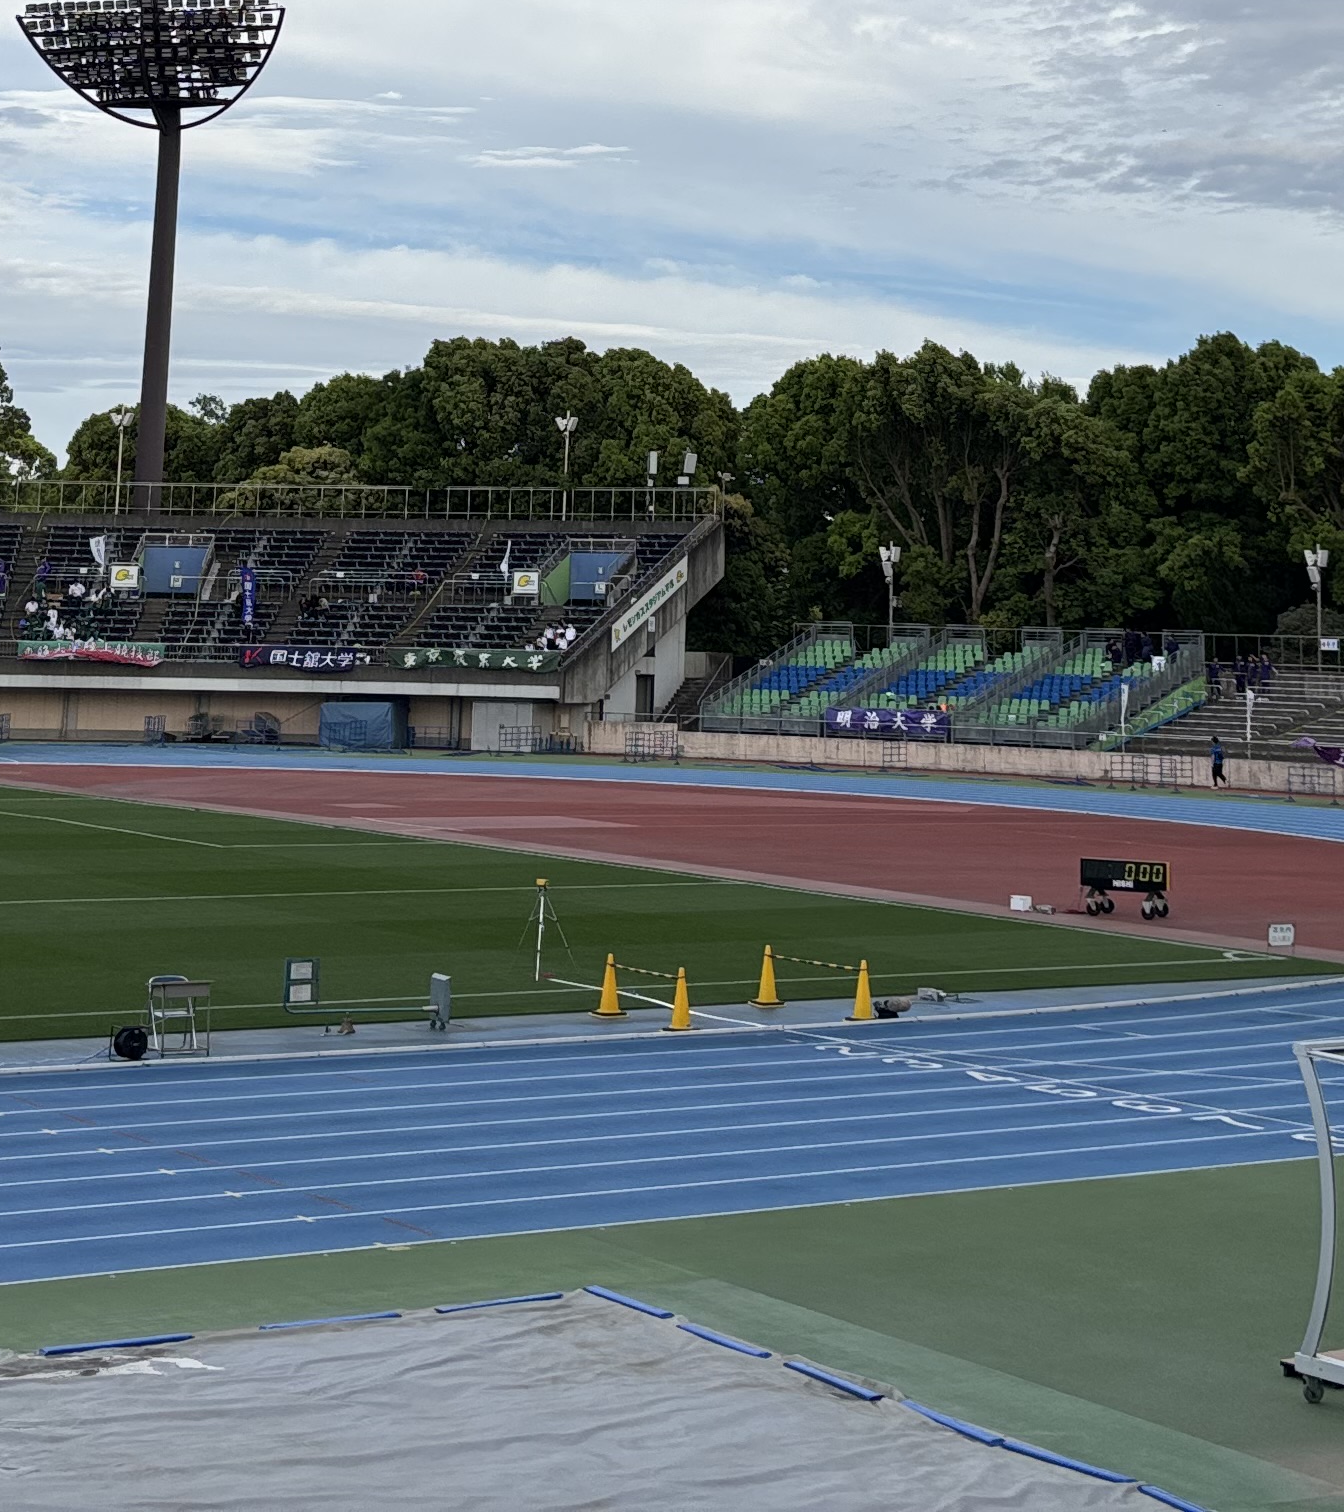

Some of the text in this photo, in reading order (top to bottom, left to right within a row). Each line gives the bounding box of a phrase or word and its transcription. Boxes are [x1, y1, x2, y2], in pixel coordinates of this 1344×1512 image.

[270, 649, 354, 668] 国士舘大学
[836, 710, 937, 733] 明治大学
[815, 1044, 879, 1057] 2
[881, 1057, 944, 1069] 3
[966, 1070, 1021, 1083] 4
[1024, 1084, 1097, 1098] 5
[1112, 1099, 1183, 1113] 6
[1190, 1115, 1265, 1130] 7
